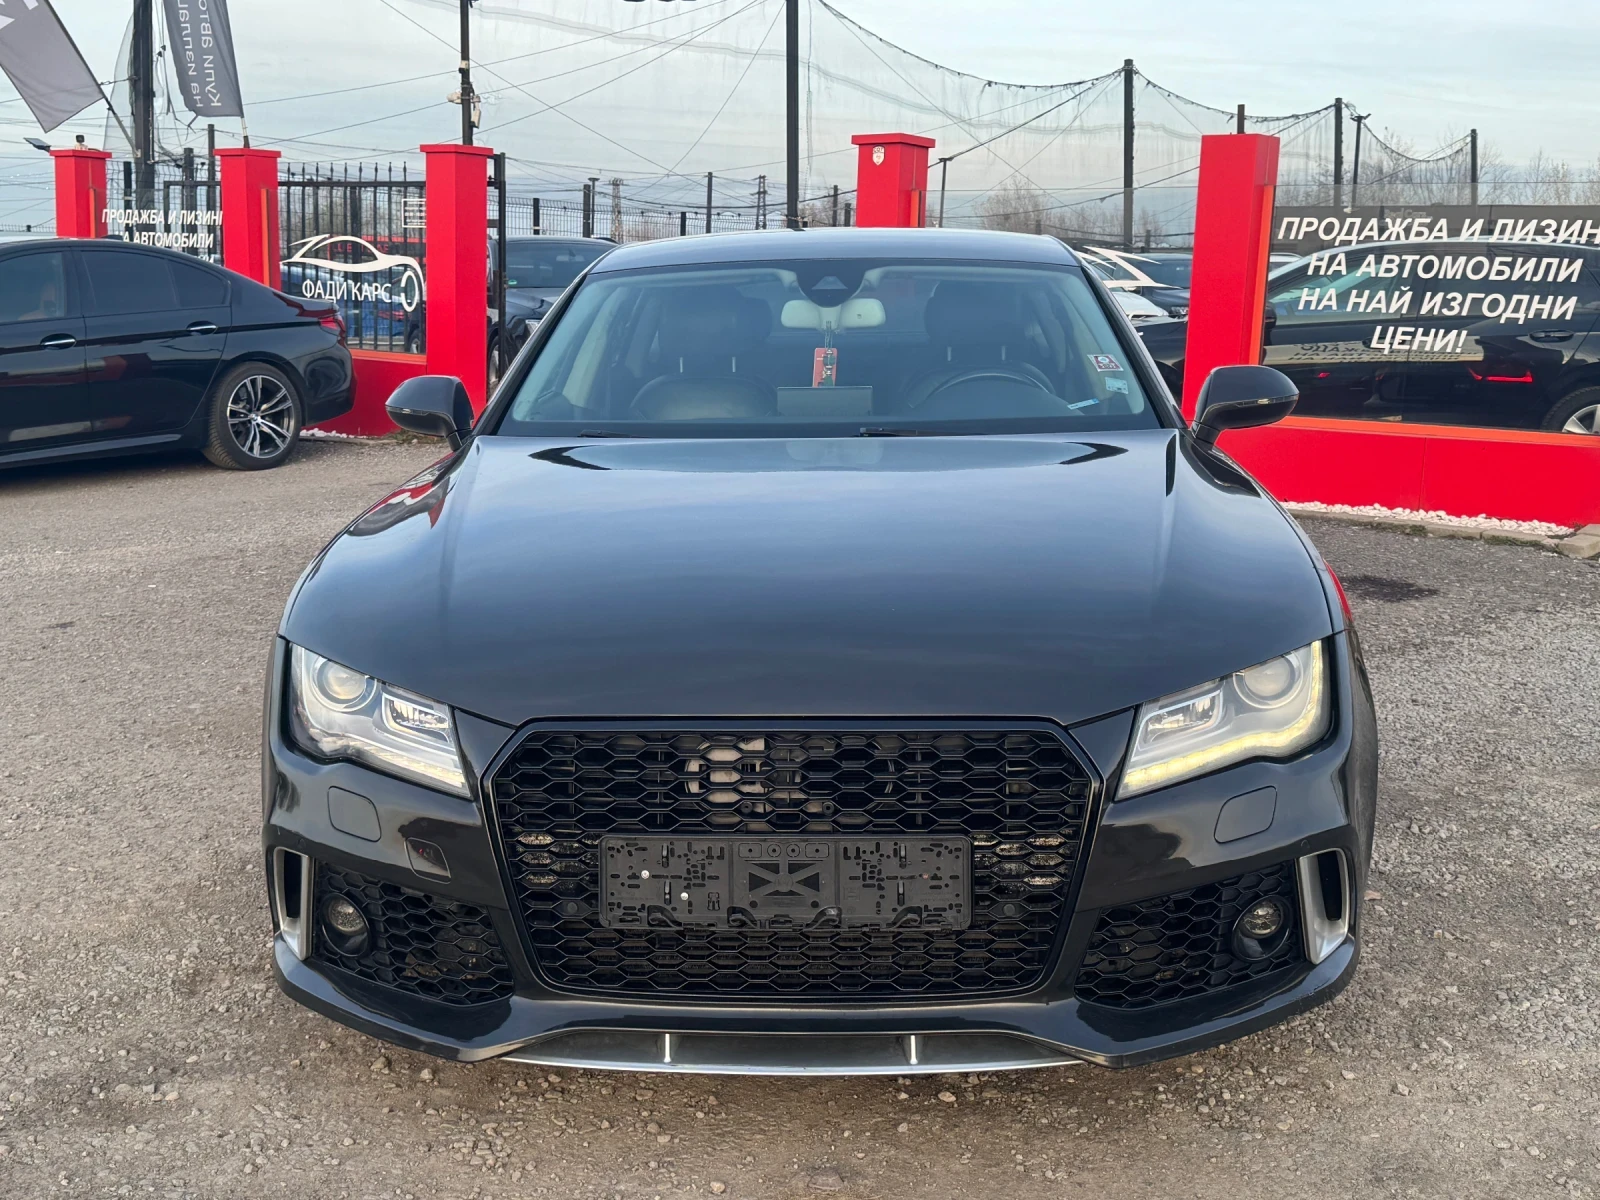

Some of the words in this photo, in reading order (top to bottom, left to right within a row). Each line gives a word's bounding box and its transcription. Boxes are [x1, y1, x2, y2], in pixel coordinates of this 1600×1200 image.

[101, 208, 165, 227] ПРОДАЖБА
[167, 210, 177, 225] И
[1277, 216, 1448, 247] ПРОДАЖБА
[1459, 218, 1485, 243] И
[133, 231, 215, 248] АВТОМОБИЛИ
[1307, 252, 1348, 277] НА
[1355, 253, 1584, 284] АВТОМОБИЛИ
[302, 278, 348, 303] ФАДИ
[351, 281, 392, 303] КАРС
[1297, 287, 1338, 312] НА
[1345, 285, 1414, 315] НАЙ
[1419, 291, 1579, 325] ИЗГОДНИ
[1369, 324, 1469, 355] ЦЕНИ!
